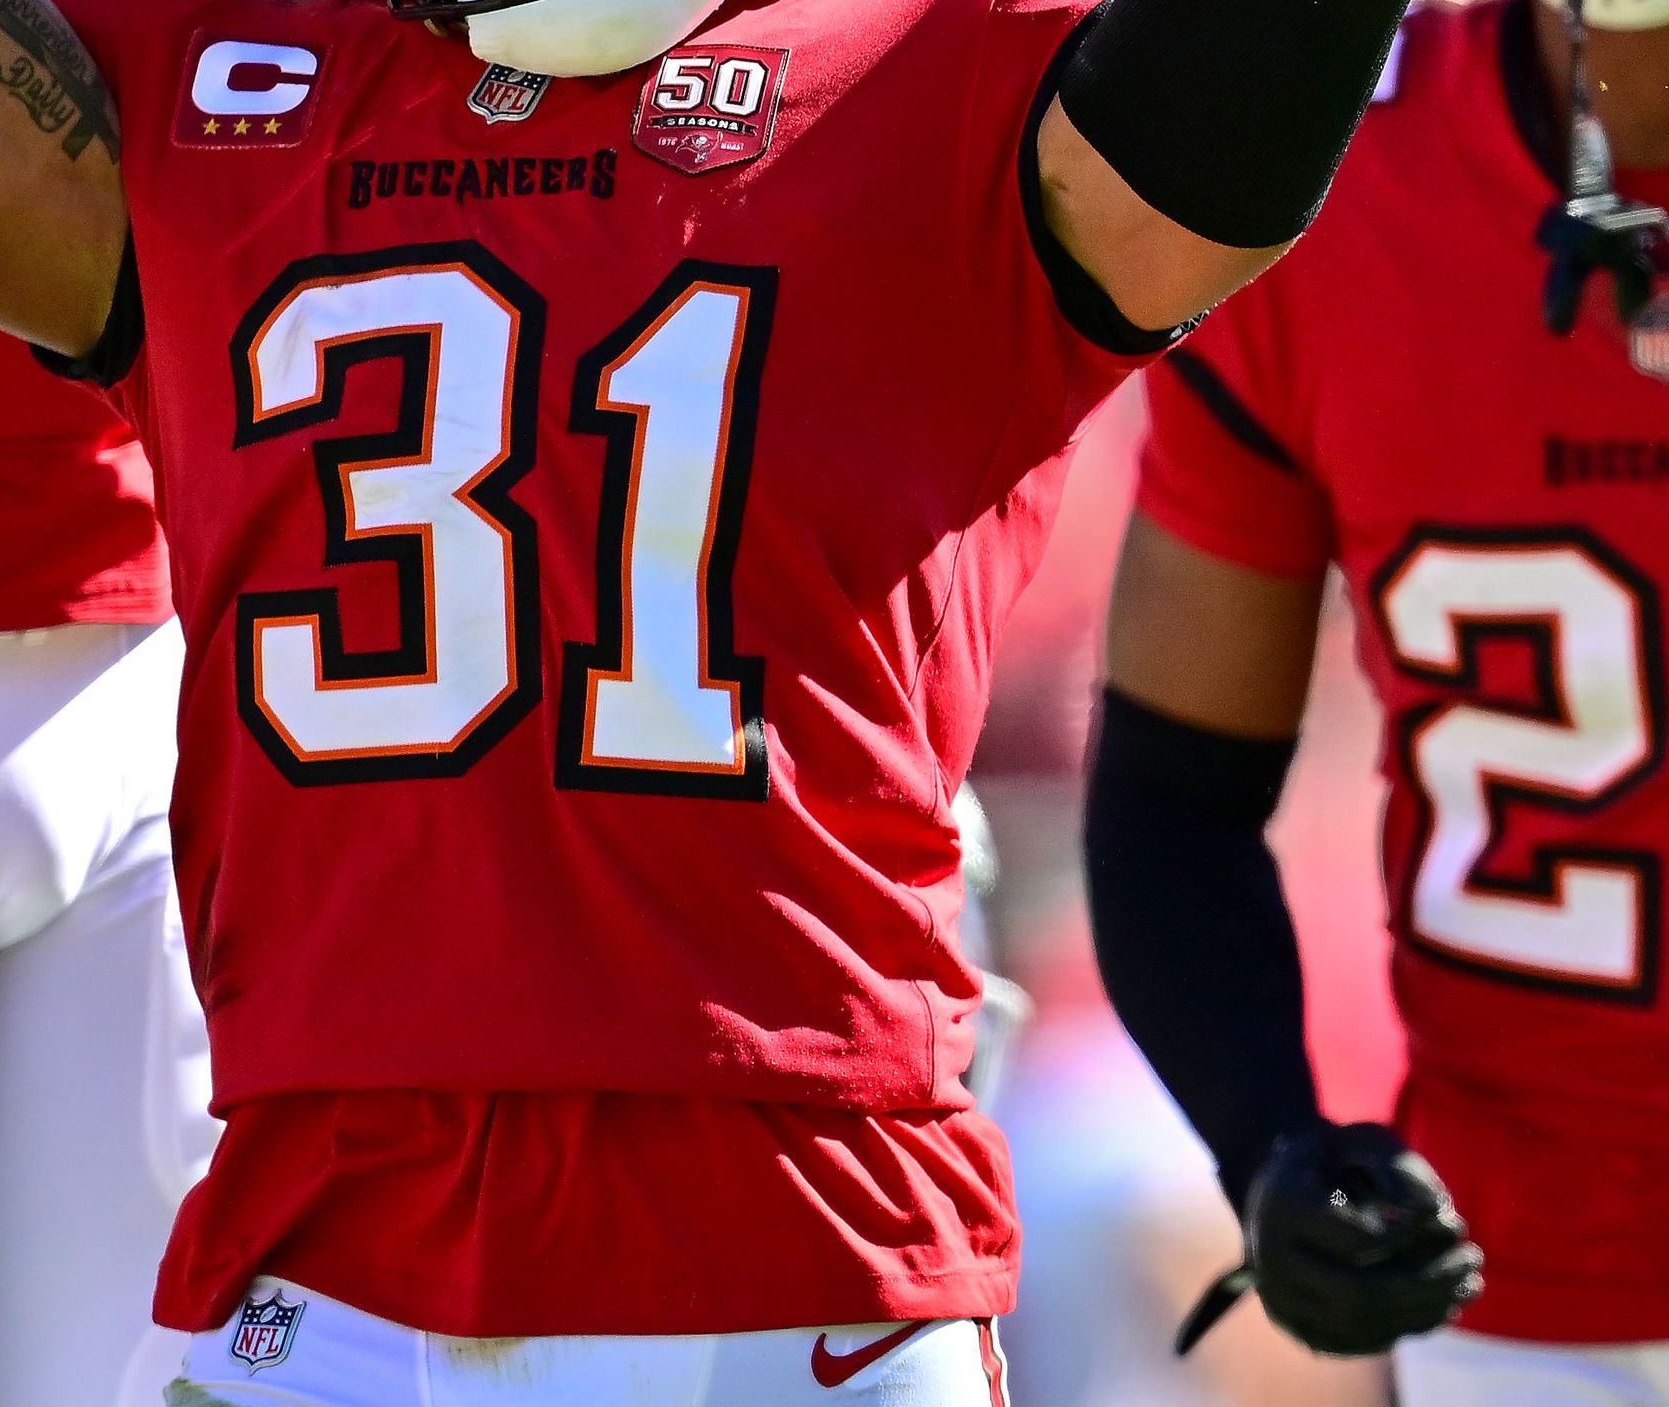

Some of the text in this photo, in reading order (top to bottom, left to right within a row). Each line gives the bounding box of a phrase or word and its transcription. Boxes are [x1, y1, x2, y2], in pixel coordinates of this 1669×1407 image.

[191, 40, 318, 115] C
[477, 81, 528, 111] NFL
[652, 56, 770, 116] 50
[666, 117, 739, 131] SEASONS
[348, 148, 618, 210] BUCCANEERS
[230, 240, 780, 794] 31
[237, 1327, 279, 1357] NFL
